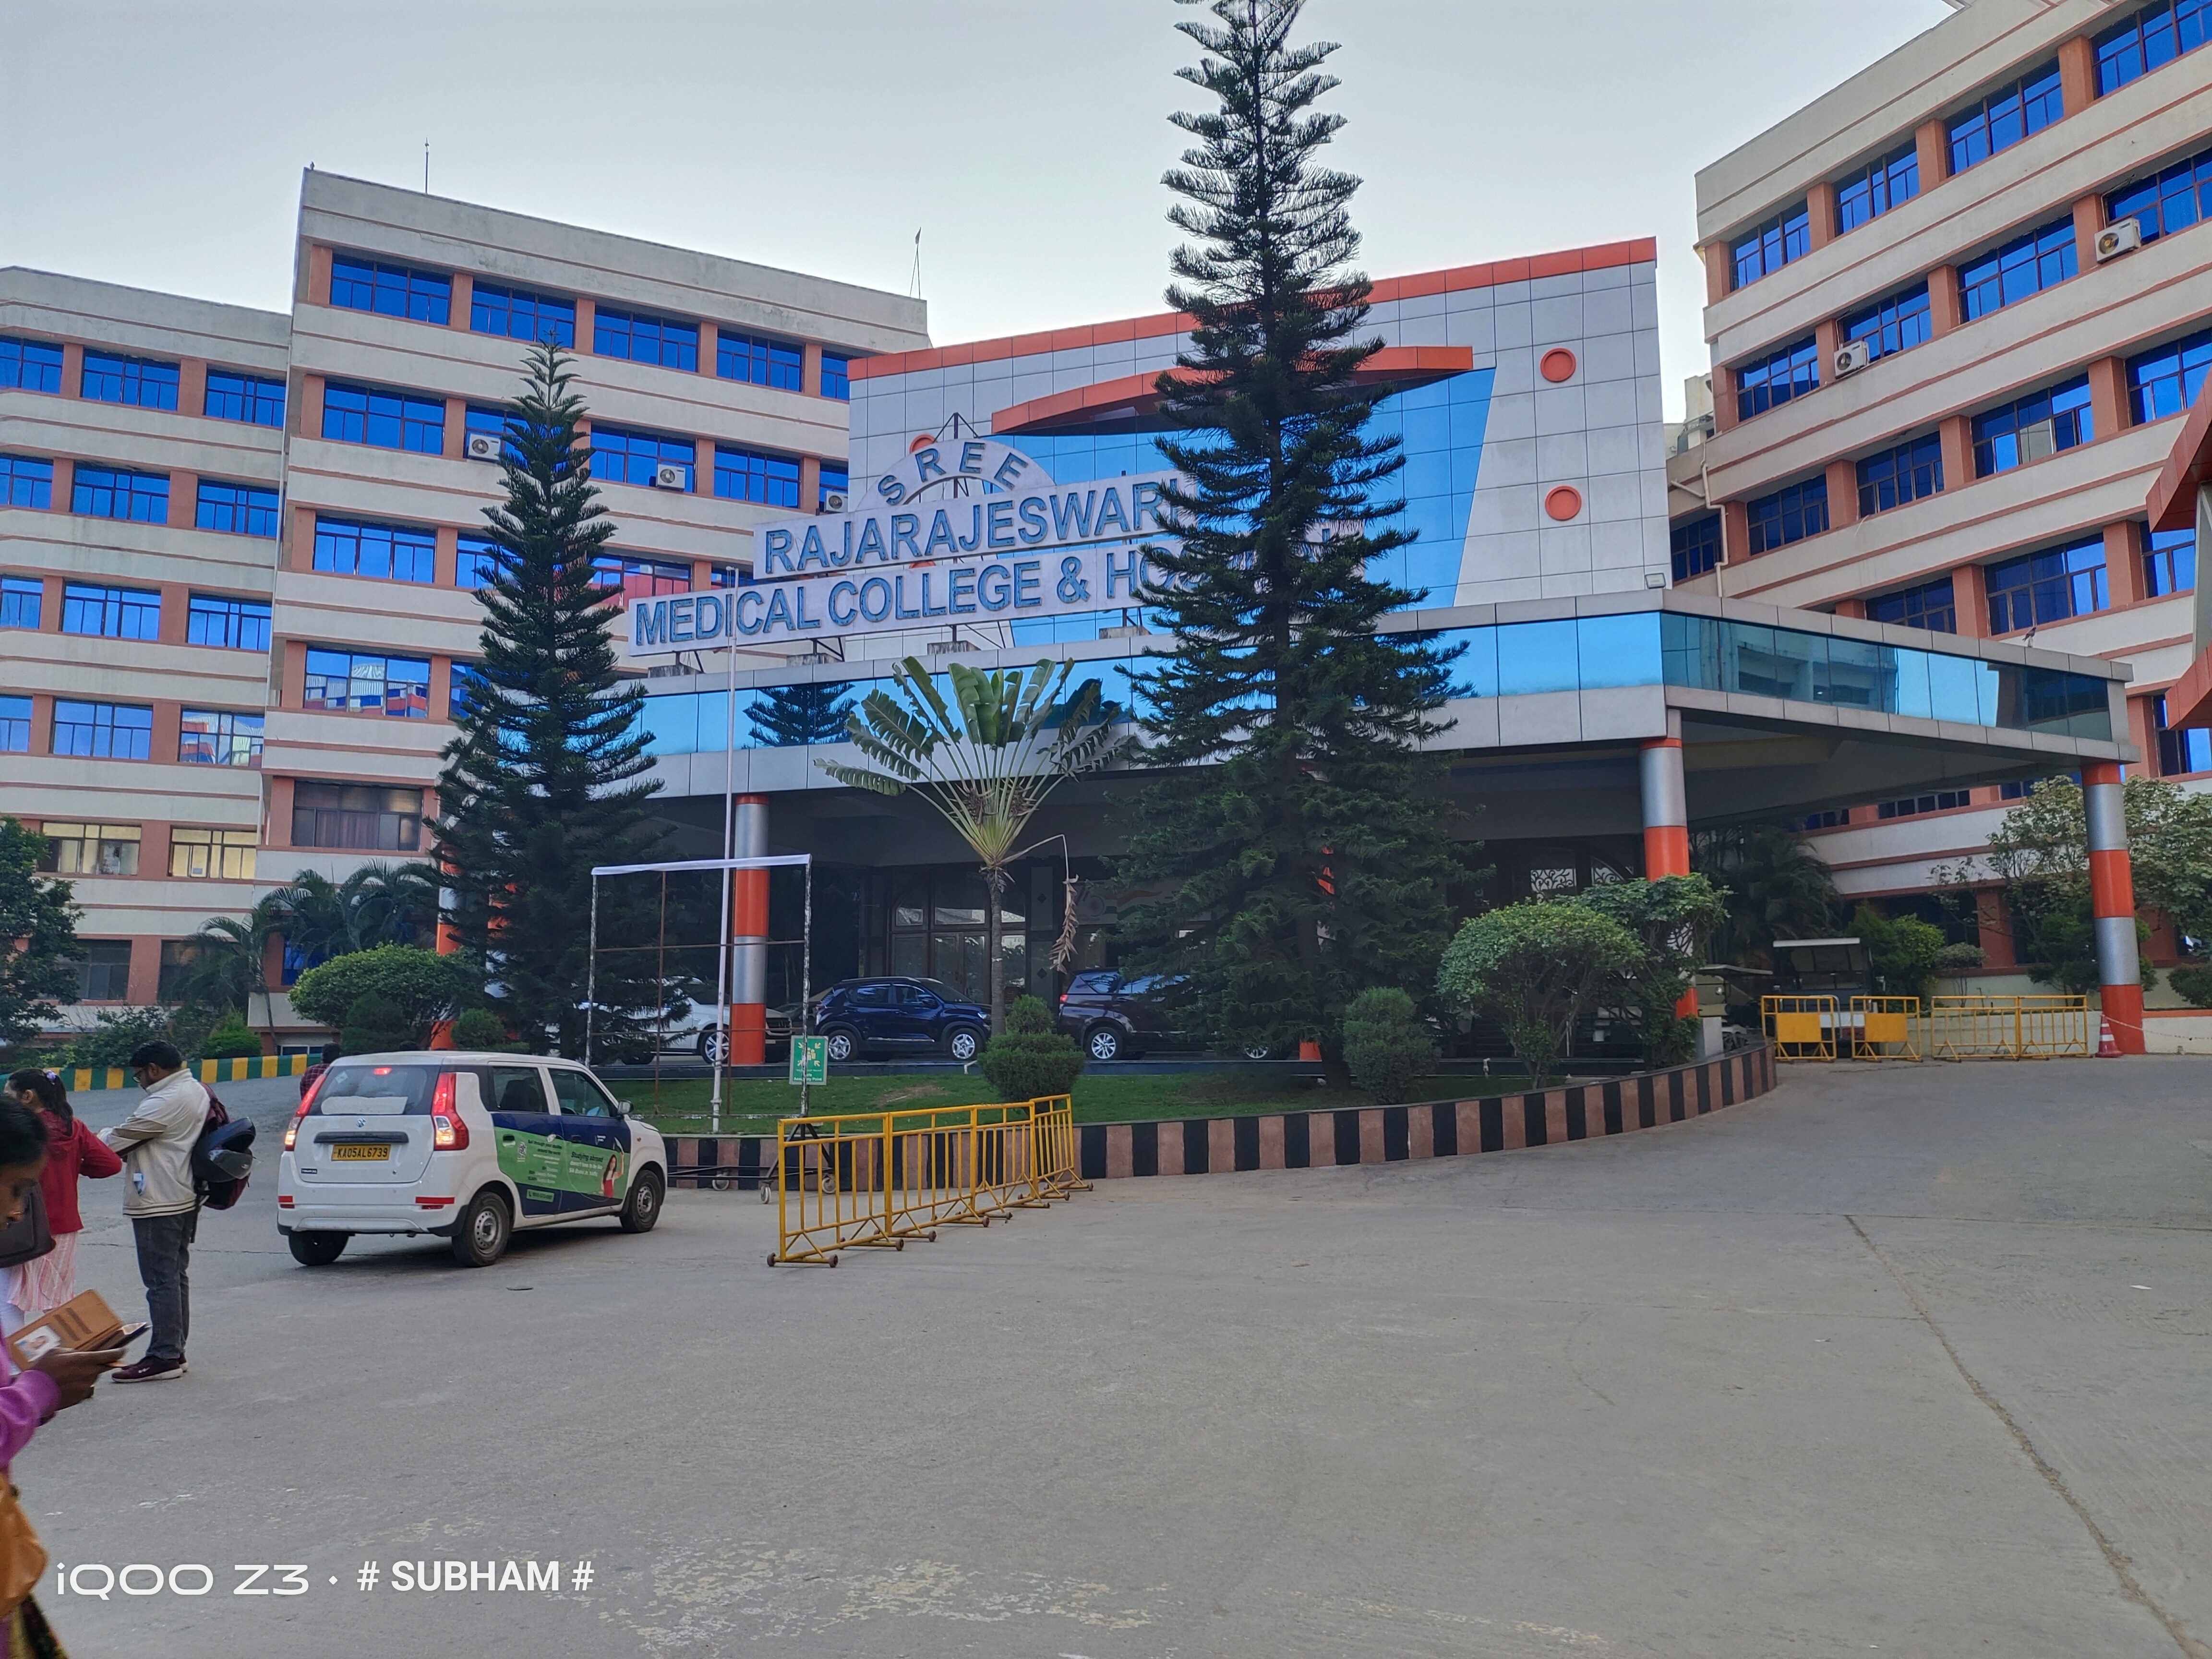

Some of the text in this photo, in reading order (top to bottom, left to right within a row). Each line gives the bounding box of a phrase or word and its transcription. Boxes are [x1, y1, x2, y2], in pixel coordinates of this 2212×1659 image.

[878, 442, 1027, 505] SREE
[766, 479, 1178, 574] RAJARAJESWARI
[636, 586, 821, 646] MEDICAL
[828, 561, 1042, 626] COLLEGE
[1057, 556, 1091, 604] &
[337, 1148, 388, 1157] KA05AL6739
[571, 1152, 589, 1161] Studying
